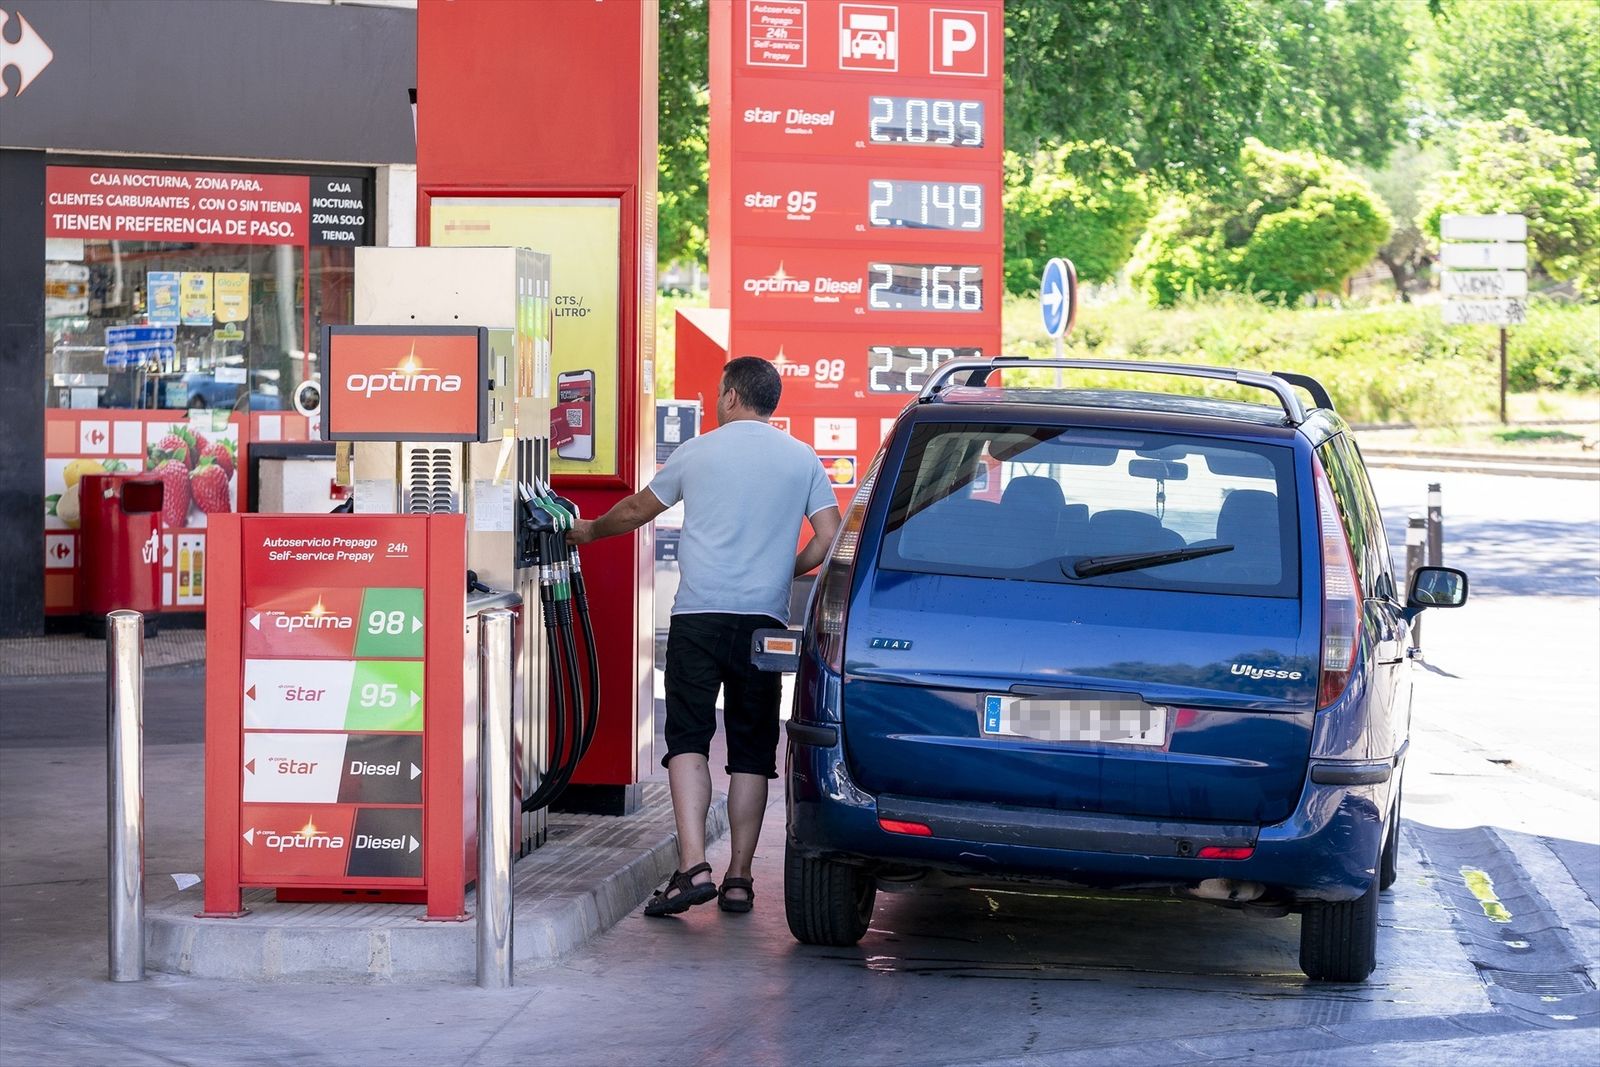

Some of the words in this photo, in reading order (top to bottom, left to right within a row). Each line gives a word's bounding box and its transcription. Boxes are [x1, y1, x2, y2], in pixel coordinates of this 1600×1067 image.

[766, 27, 788, 39] 24h
[942, 18, 977, 67] P
[744, 108, 781, 124] star
[785, 109, 835, 126] Diesel
[870, 97, 982, 146] 2.095
[90, 173, 122, 187] CAJA
[122, 174, 192, 190] NOCTURNA,
[195, 177, 229, 191] ZONA
[230, 179, 263, 193] PARA.
[328, 182, 351, 194] CAJA
[49, 193, 104, 206] CLIENTES
[106, 195, 190, 210] CARBURANTES
[198, 198, 226, 211] CON
[228, 199, 238, 212] O
[239, 200, 259, 212] SIN
[260, 200, 302, 214] TIENDA
[312, 197, 363, 210] NOCTURNA
[744, 191, 782, 208] star
[786, 190, 817, 214] 95
[870, 181, 981, 228] 2.149
[53, 213, 112, 231] TIENEN
[115, 216, 225, 235] PREFERENCIA
[228, 218, 249, 236] DE
[250, 219, 294, 238] PASO.
[312, 213, 339, 225] ZONA
[339, 214, 365, 226] SOLO
[322, 230, 355, 241] TIENDA
[743, 278, 810, 296] optima
[814, 277, 862, 294] Diesel
[870, 264, 981, 310] 2.166
[555, 295, 583, 306] CTS./
[814, 359, 846, 382] 98
[346, 371, 462, 398] optima
[263, 537, 330, 548] Autoservicio
[332, 537, 378, 549] Prepago
[387, 543, 408, 553] 24h
[268, 551, 334, 561] Self-service
[336, 551, 374, 562] Prepay
[275, 614, 352, 633] optima
[367, 610, 405, 635] 98
[872, 639, 911, 649] FIAT
[1230, 663, 1302, 681] Ulysse
[285, 686, 326, 702] star
[360, 683, 398, 708] 95
[989, 718, 997, 727] E
[278, 759, 318, 775] star
[350, 761, 400, 776] Diesel
[266, 834, 344, 853] optima
[355, 834, 405, 850] Diesel
